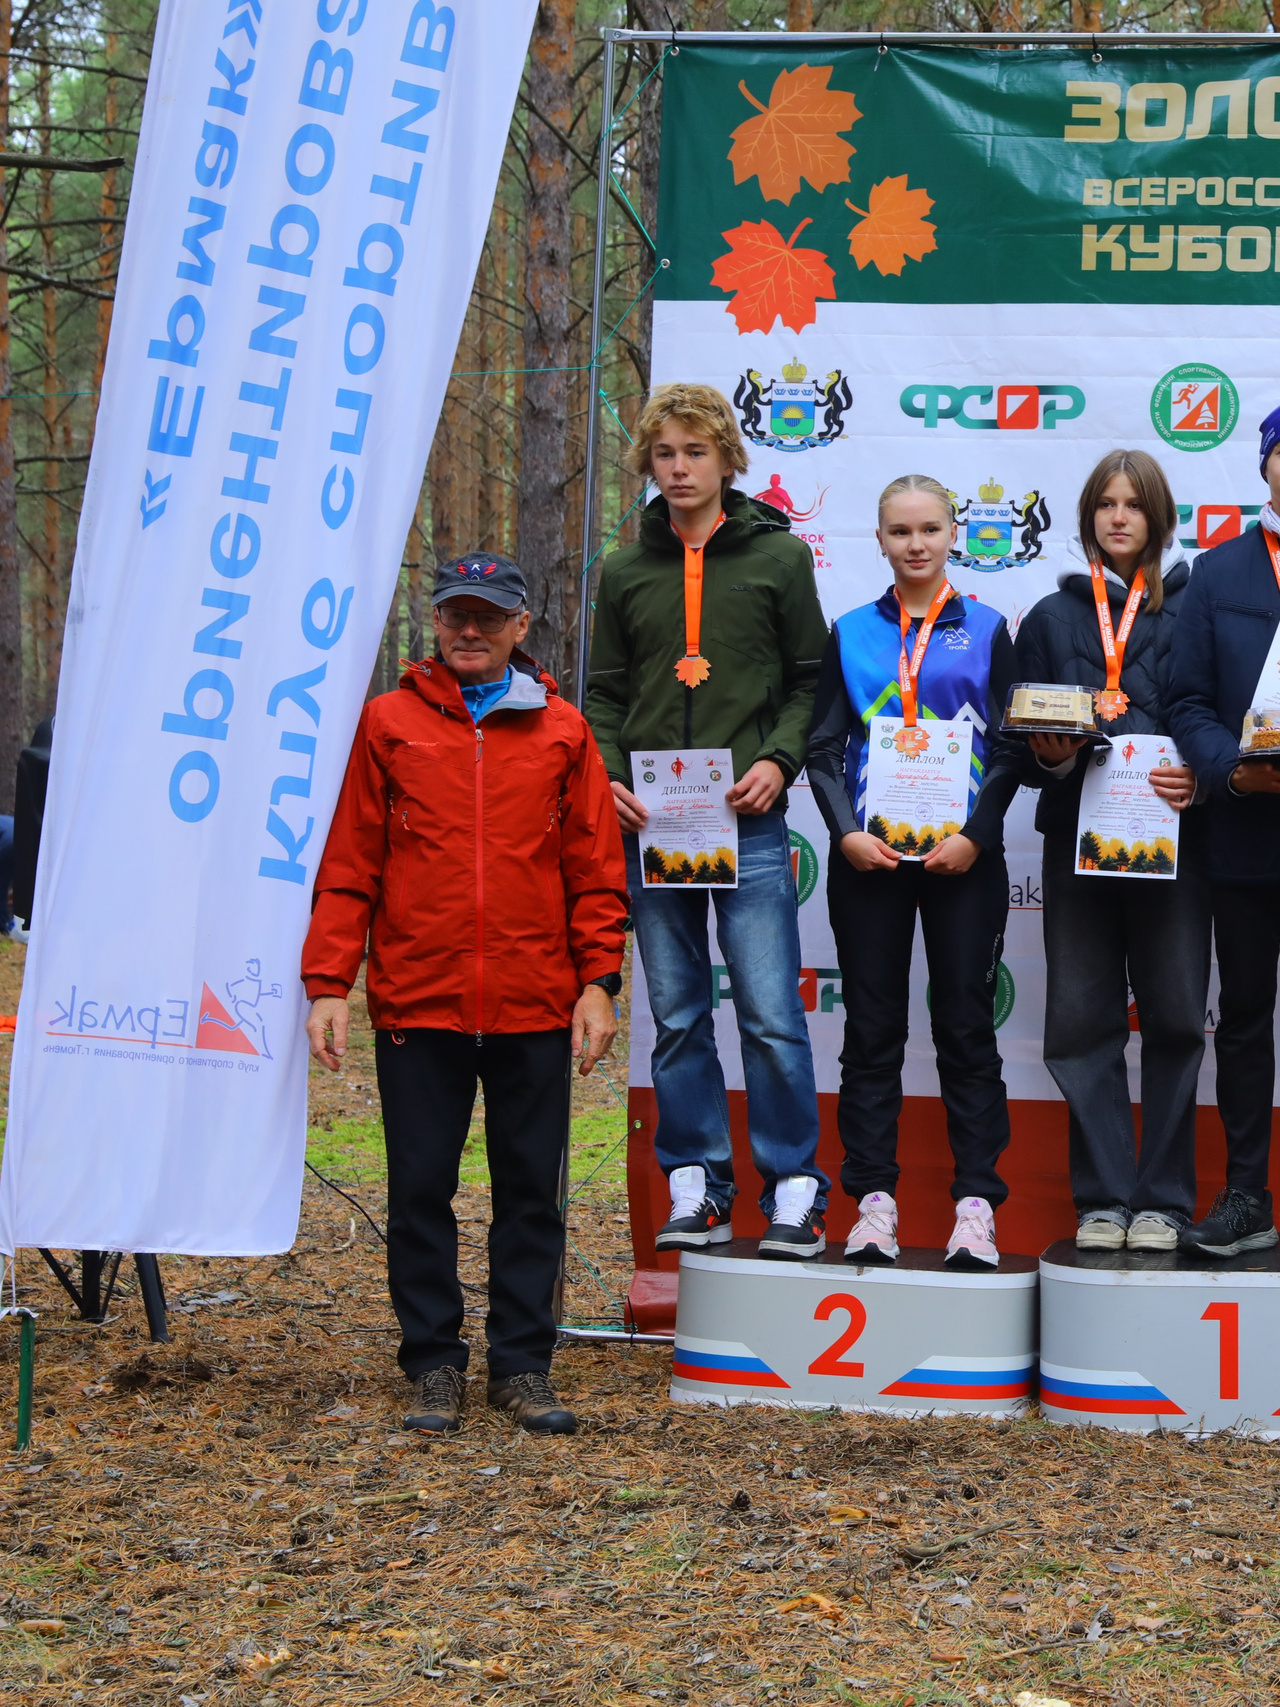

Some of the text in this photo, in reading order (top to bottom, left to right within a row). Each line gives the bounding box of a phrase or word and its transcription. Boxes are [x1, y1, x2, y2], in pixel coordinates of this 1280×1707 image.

[1155, 374, 1176, 408] ФЕДЕРАЦИЯ
[1178, 367, 1222, 381] СПОРТИВНОГО
[1217, 384, 1236, 439] ОРИЕНТИРОВАНИЯ
[796, 534, 825, 544] БОК
[1115, 695, 1121, 704] 1
[914, 731, 923, 740] 2
[1108, 770, 1149, 780] ДИПЛО
[661, 785, 710, 796] ДИПЛОМ
[808, 1293, 867, 1378] 2
[1200, 1302, 1240, 1400] 1
